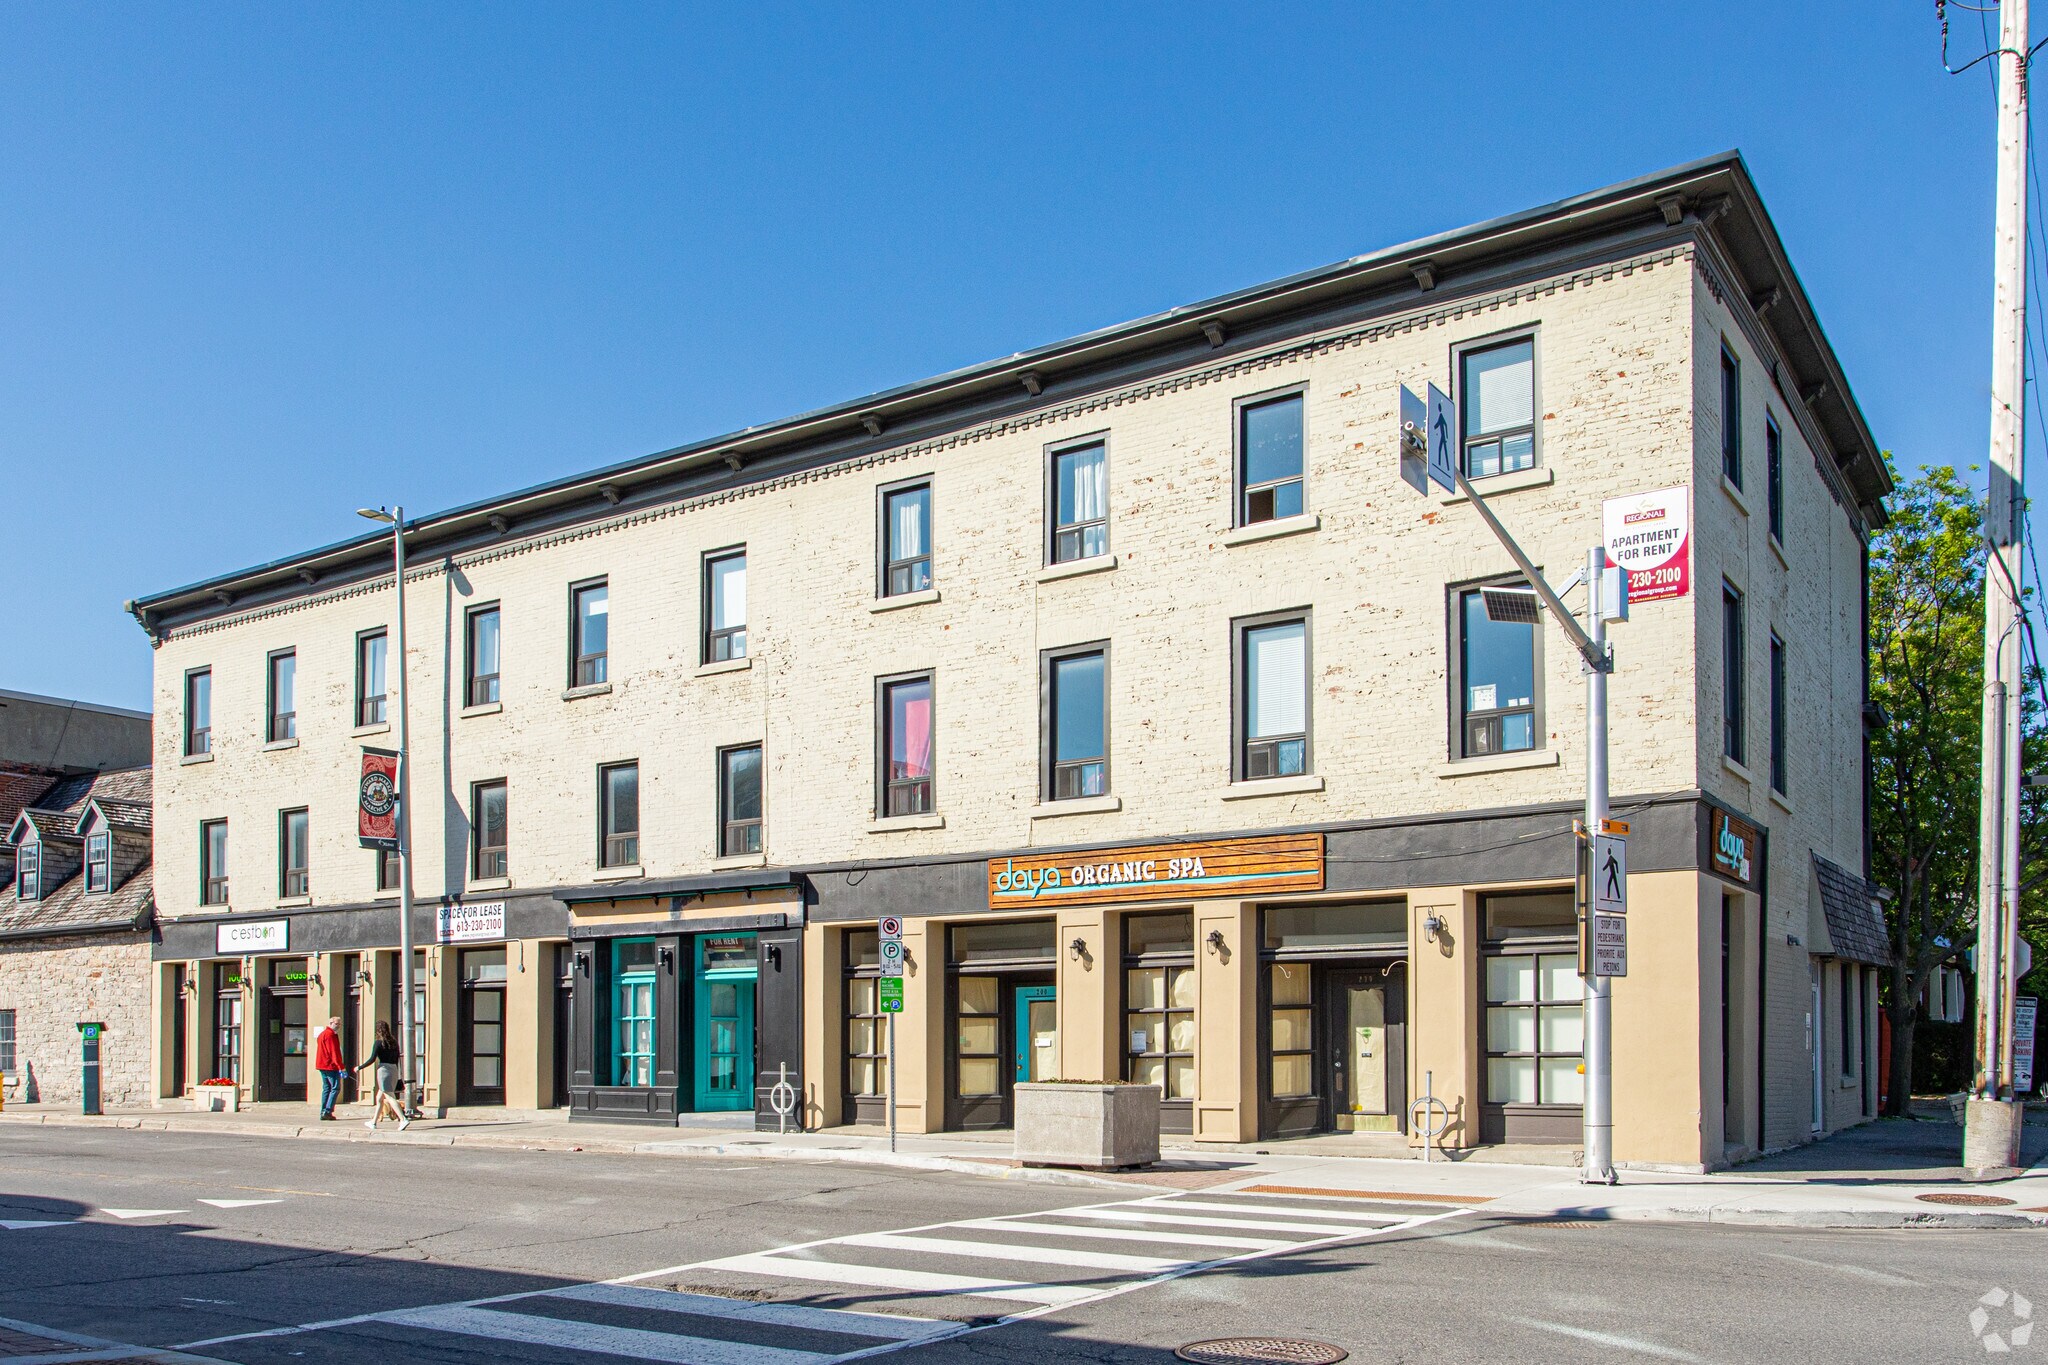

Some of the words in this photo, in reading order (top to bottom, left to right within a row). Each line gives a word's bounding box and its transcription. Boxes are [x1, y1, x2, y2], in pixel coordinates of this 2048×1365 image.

[1626, 510, 1664, 523] REGIONAL
[1612, 527, 1680, 549] APARTMENT
[1617, 548, 1640, 562] FOR
[1643, 542, 1673, 557] RENT
[362, 775, 378, 793] BYWARD
[378, 777, 393, 796] MARKET
[1720, 815, 1745, 870] daya
[996, 859, 1062, 898] daya
[1071, 860, 1157, 886] ORGANIC
[1168, 856, 1206, 879] SPA
[439, 906, 461, 920] SPACE
[463, 906, 478, 918] FOR
[480, 904, 502, 917] LEASE
[456, 918, 502, 932] 613-230-2100
[1600, 919, 1611, 930] STOP
[1612, 920, 1621, 930] FOR
[709, 937, 723, 946] FOR
[723, 937, 739, 945] RENT
[1597, 932, 1625, 943] PEDESTRIANS
[1616, 949, 1625, 959] AUX
